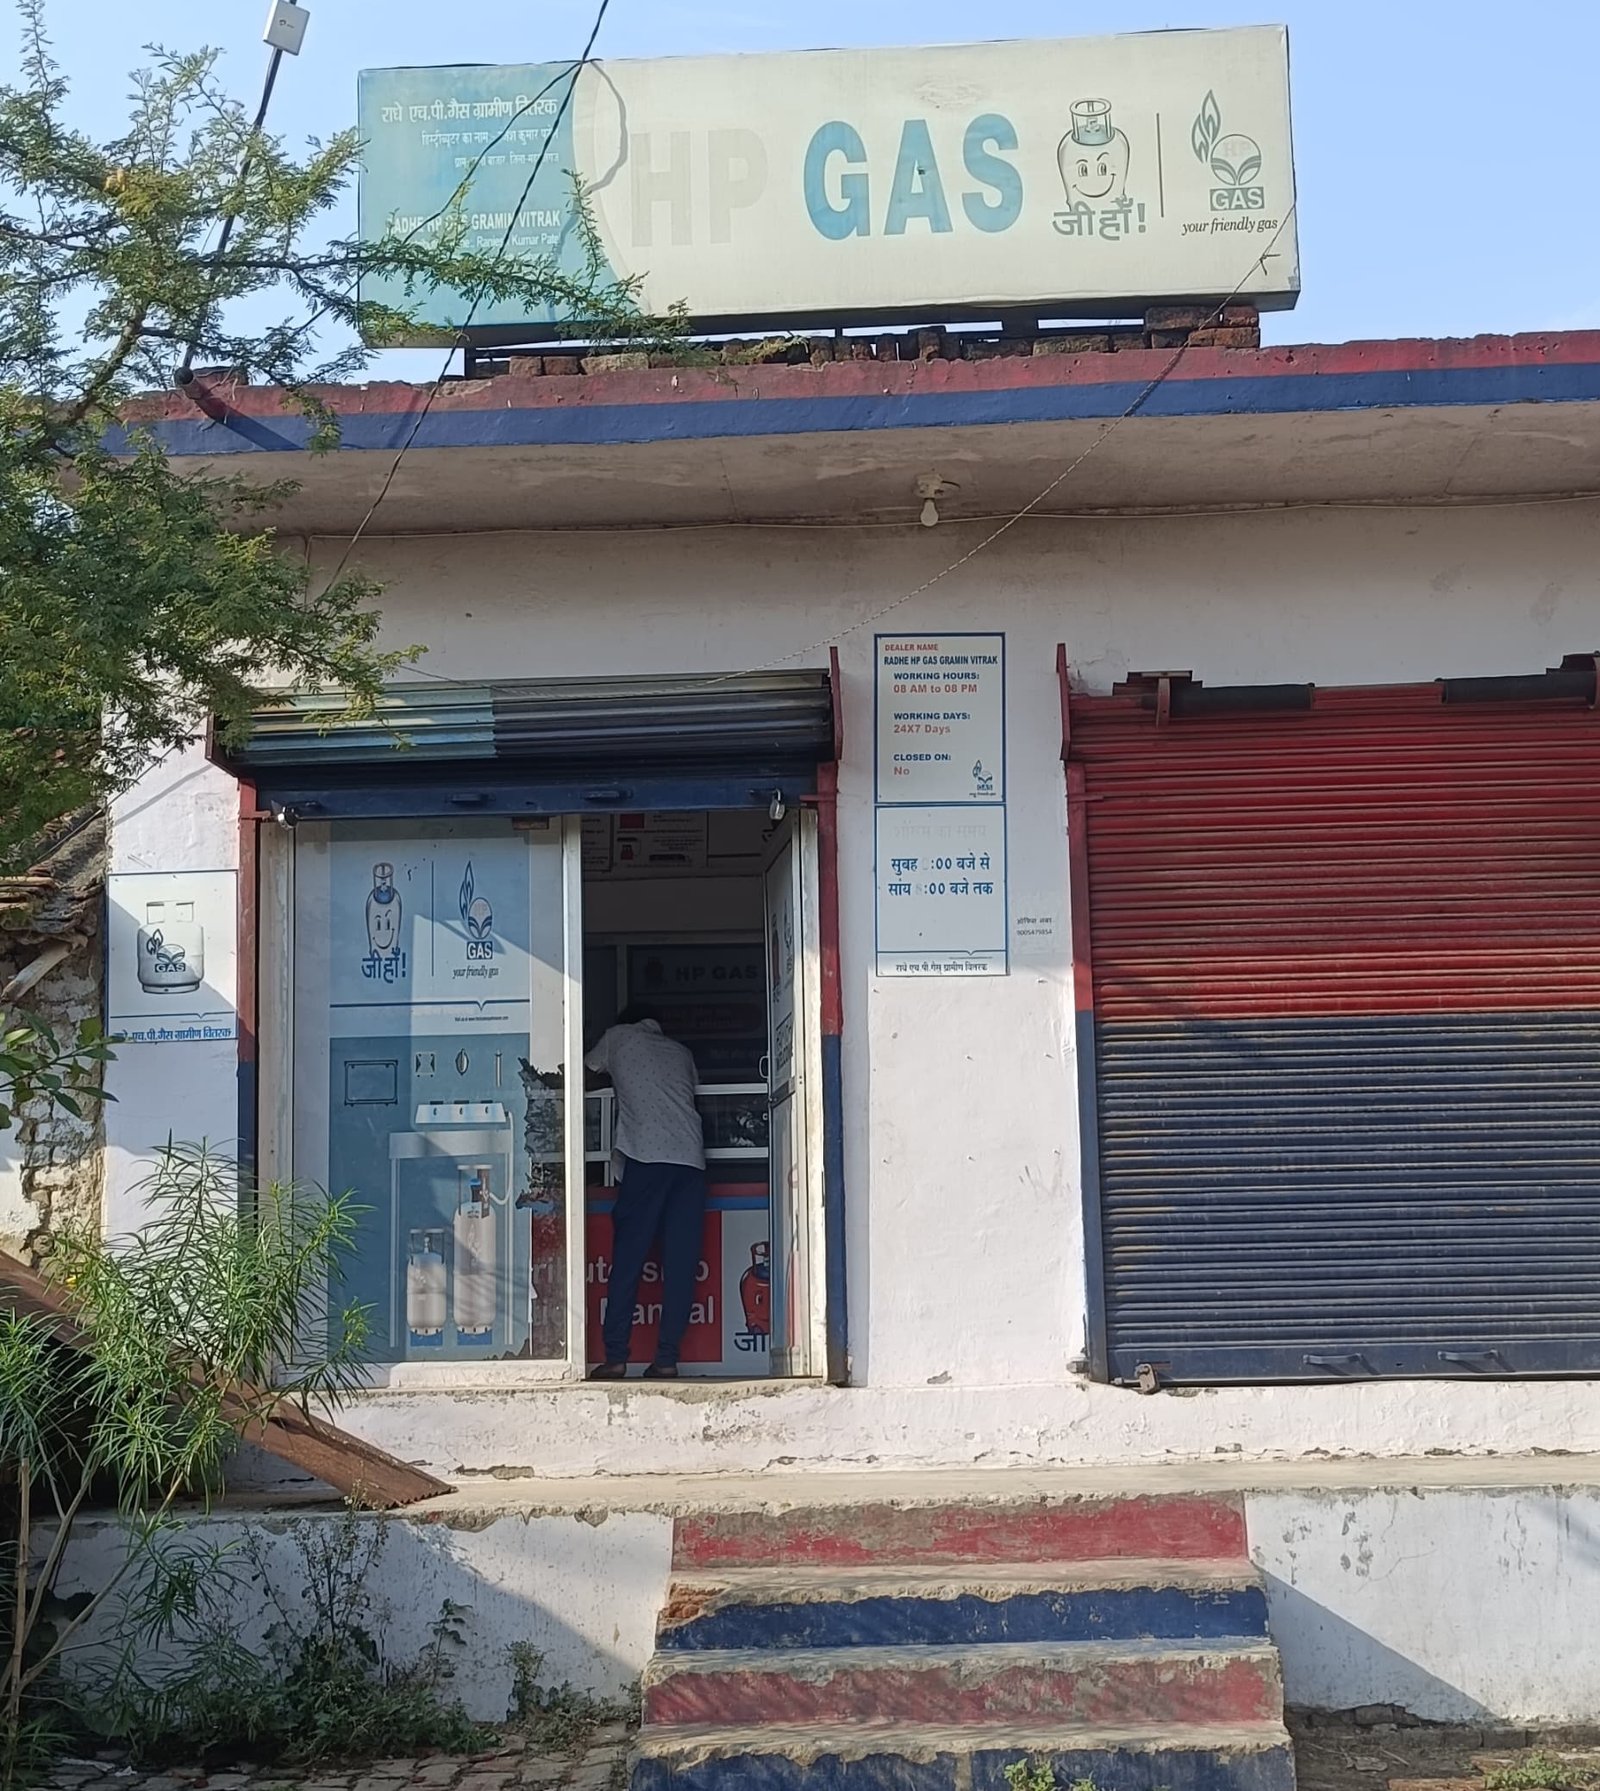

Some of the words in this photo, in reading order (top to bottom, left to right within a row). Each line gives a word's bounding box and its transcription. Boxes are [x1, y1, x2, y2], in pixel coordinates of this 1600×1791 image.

[381, 102, 403, 122] राधे
[473, 96, 512, 120] ग्रामीण
[630, 128, 768, 247] HP
[803, 113, 1023, 240] GAS
[1211, 188, 1263, 210] GAS
[519, 210, 561, 228] VITRAK
[1052, 200, 1096, 236] जी
[1181, 222, 1209, 236] your
[1210, 216, 1255, 235] friendly
[1257, 219, 1278, 233] gas
[884, 644, 915, 652] DEALER
[916, 643, 939, 651] NAME
[884, 656, 909, 665] RADHE
[910, 656, 921, 665] HP
[922, 656, 938, 664] GAS
[939, 656, 968, 664] GRAMIN
[970, 655, 998, 664] VITRAK
[893, 672, 940, 680] WORKING
[942, 672, 980, 680] HOURS:
[893, 684, 907, 693] 08
[910, 684, 927, 693] AM
[931, 684, 941, 693] to
[944, 684, 958, 692] 08
[961, 684, 977, 692] PM
[893, 712, 940, 720] WORKING
[943, 712, 971, 720] DAYS:
[893, 724, 921, 733] 24X7
[924, 724, 951, 736] Days
[893, 753, 932, 761] CLOSED
[934, 753, 951, 761] ON:
[893, 766, 910, 775] No
[979, 852, 991, 870] से
[973, 882, 994, 895] तक
[467, 942, 493, 958] GAS
[155, 963, 185, 972] GAS
[361, 949, 382, 979] जी
[711, 964, 759, 981] GAS
